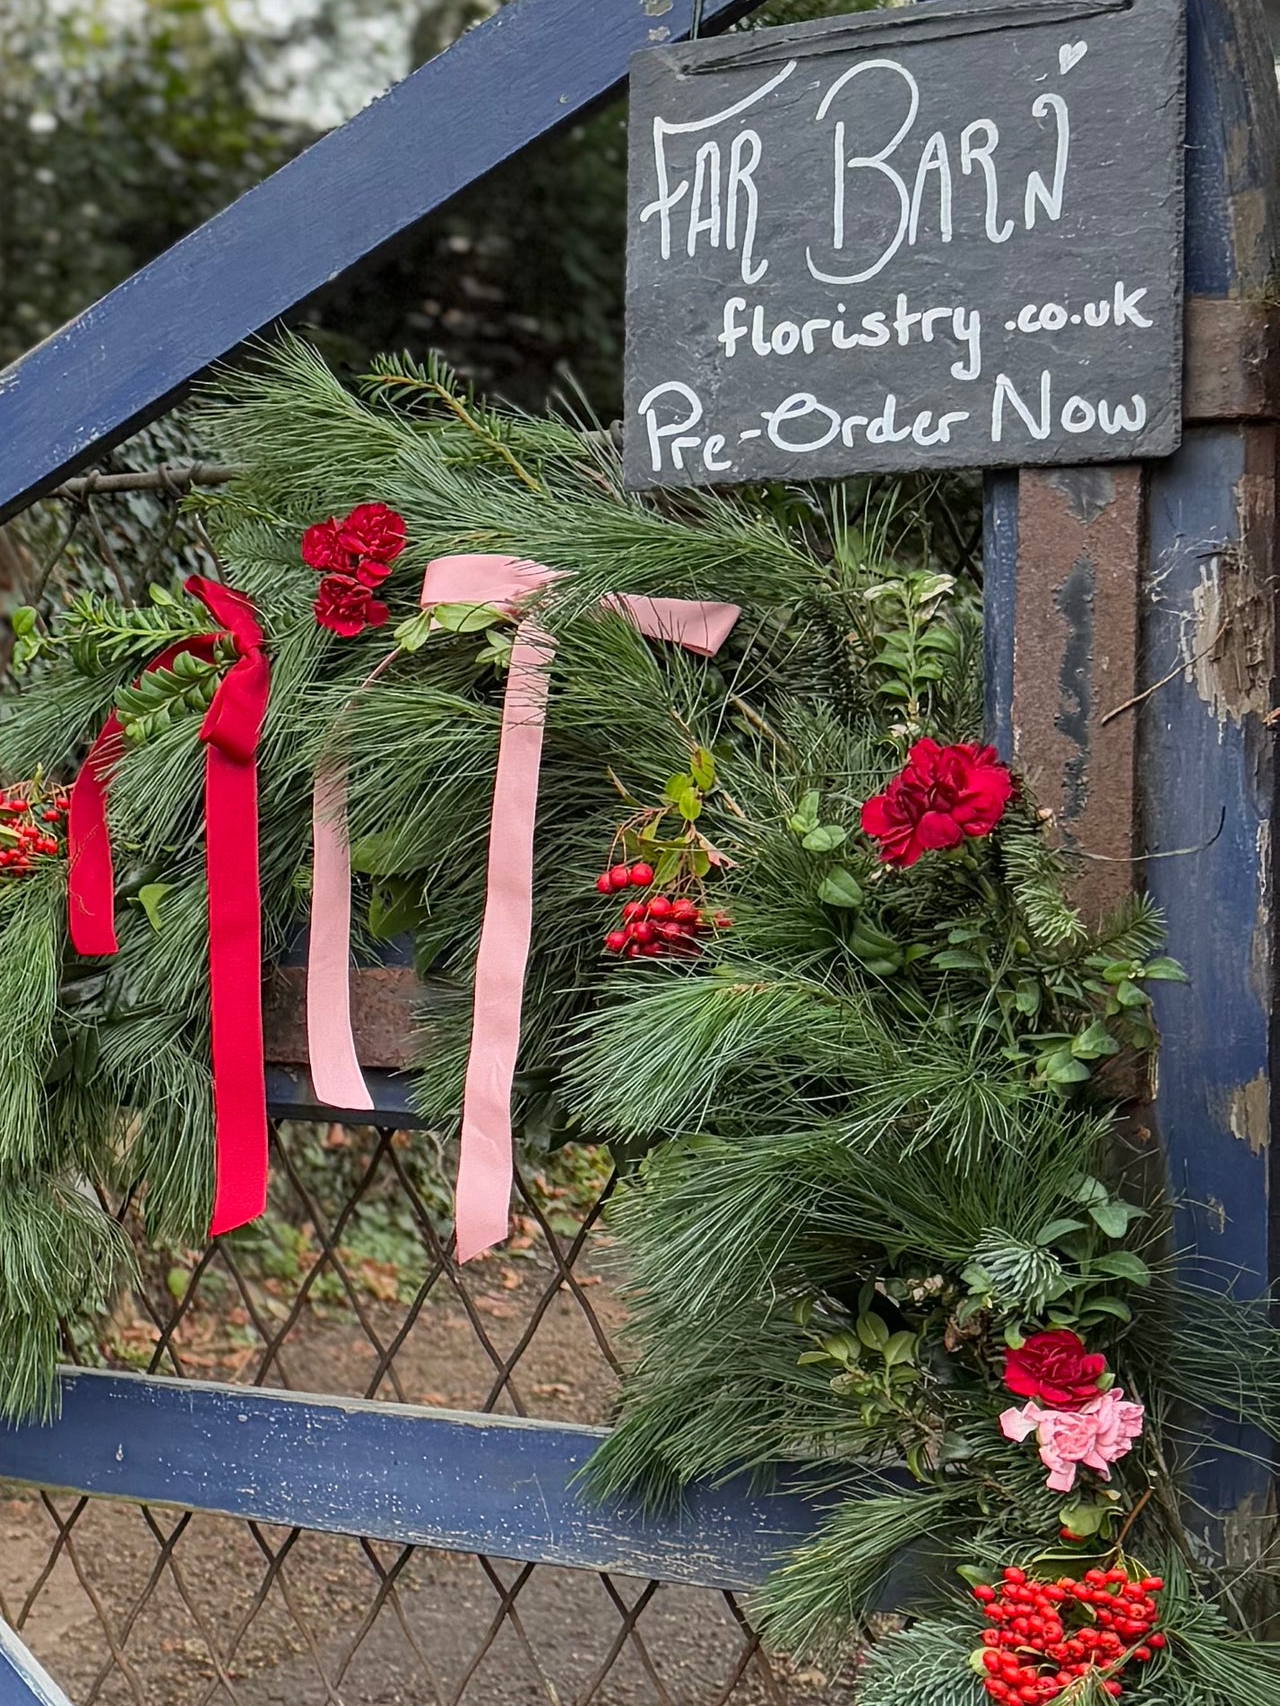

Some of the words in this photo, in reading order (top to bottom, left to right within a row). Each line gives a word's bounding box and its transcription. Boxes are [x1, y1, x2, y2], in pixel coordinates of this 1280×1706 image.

[639, 60, 797, 284] FAR
[806, 58, 1071, 285] BARN
[638, 380, 970, 472] Pre-Order
[991, 369, 1147, 443] Now
